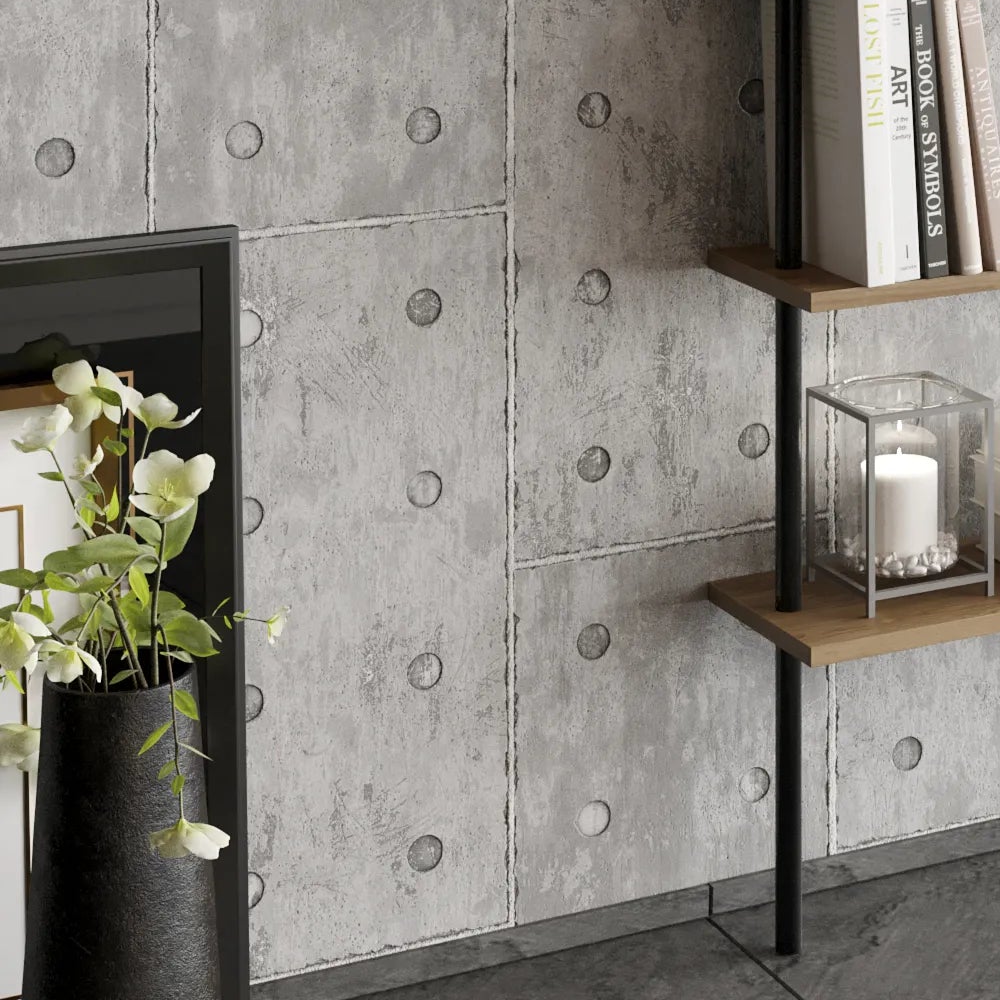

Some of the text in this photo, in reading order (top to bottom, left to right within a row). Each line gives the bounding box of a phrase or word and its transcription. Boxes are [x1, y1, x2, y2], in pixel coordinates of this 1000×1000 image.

[864, 3, 884, 127] LOST FISH
[891, 65, 909, 108] ART
[948, 54, 960, 89] WORLD
[892, 133, 912, 142] Century
[915, 24, 944, 238] THE BOOK OF SYMBOLS
